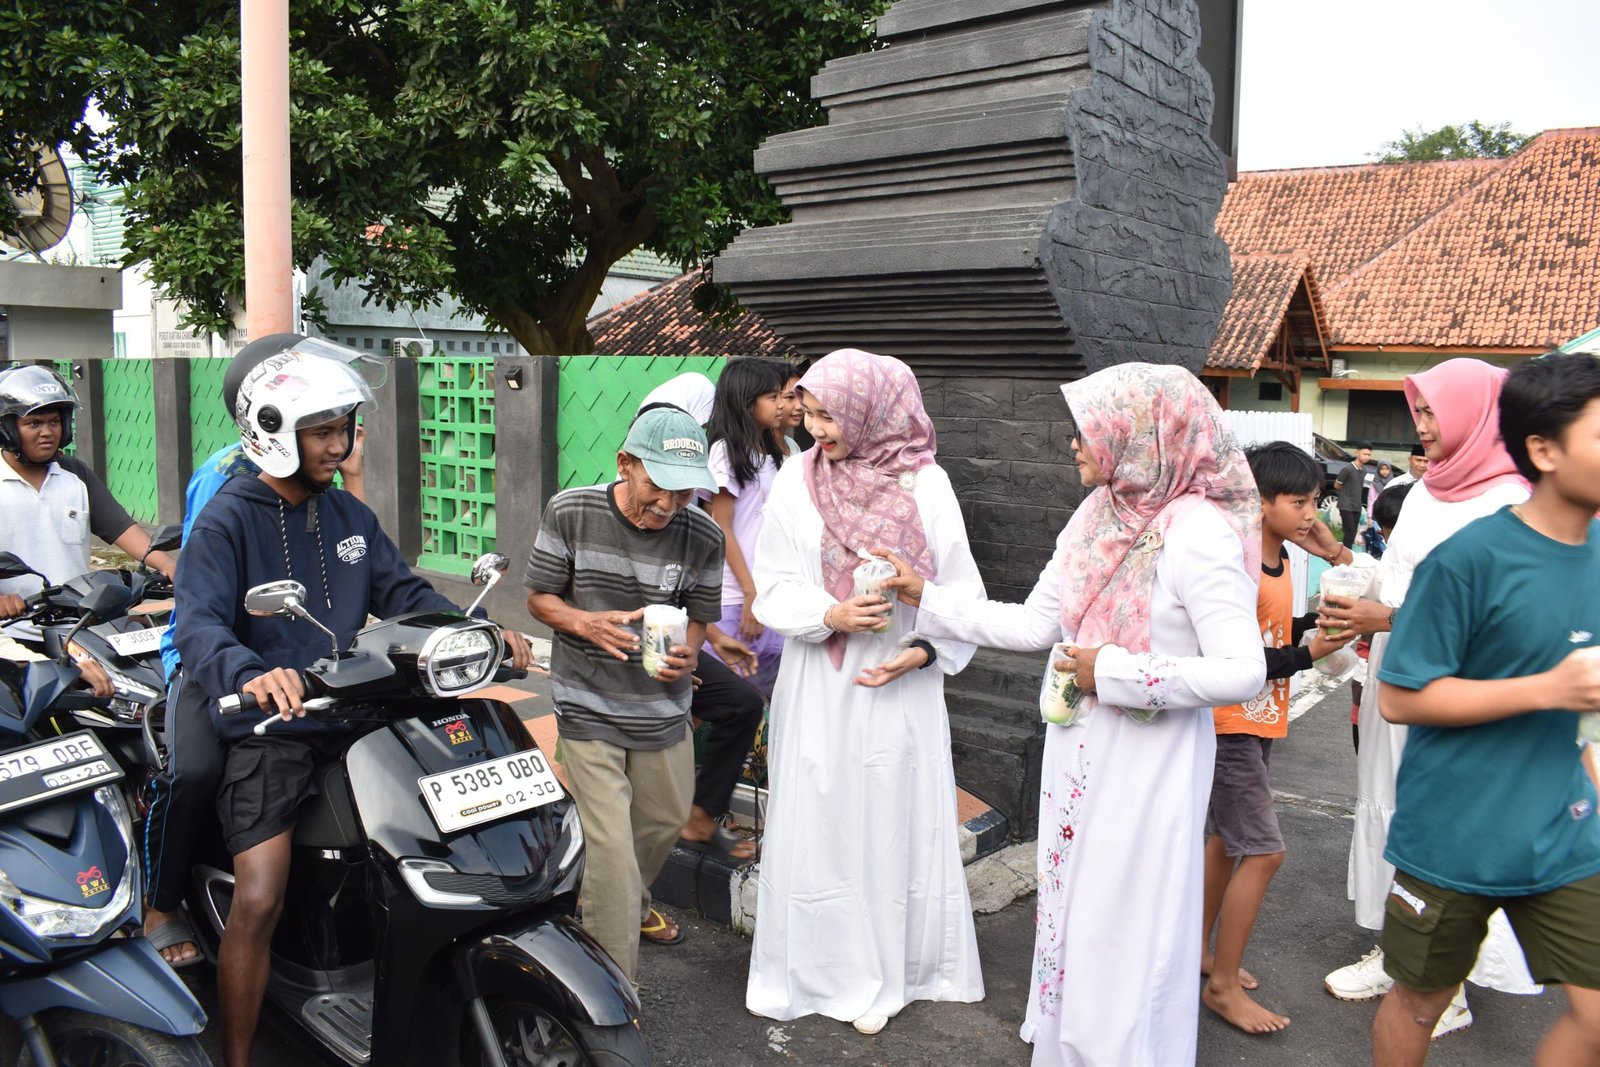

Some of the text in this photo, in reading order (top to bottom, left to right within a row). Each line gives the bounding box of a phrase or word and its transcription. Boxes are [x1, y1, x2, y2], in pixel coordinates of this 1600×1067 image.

[662, 438, 704, 455] BROOKLYN
[336, 535, 366, 554] ACTION
[113, 636, 121, 646] P
[126, 630, 155, 643] 3009
[432, 714, 470, 727] HONDA
[430, 781, 442, 802] P
[451, 766, 503, 795] 5385
[461, 801, 501, 816] cool power
